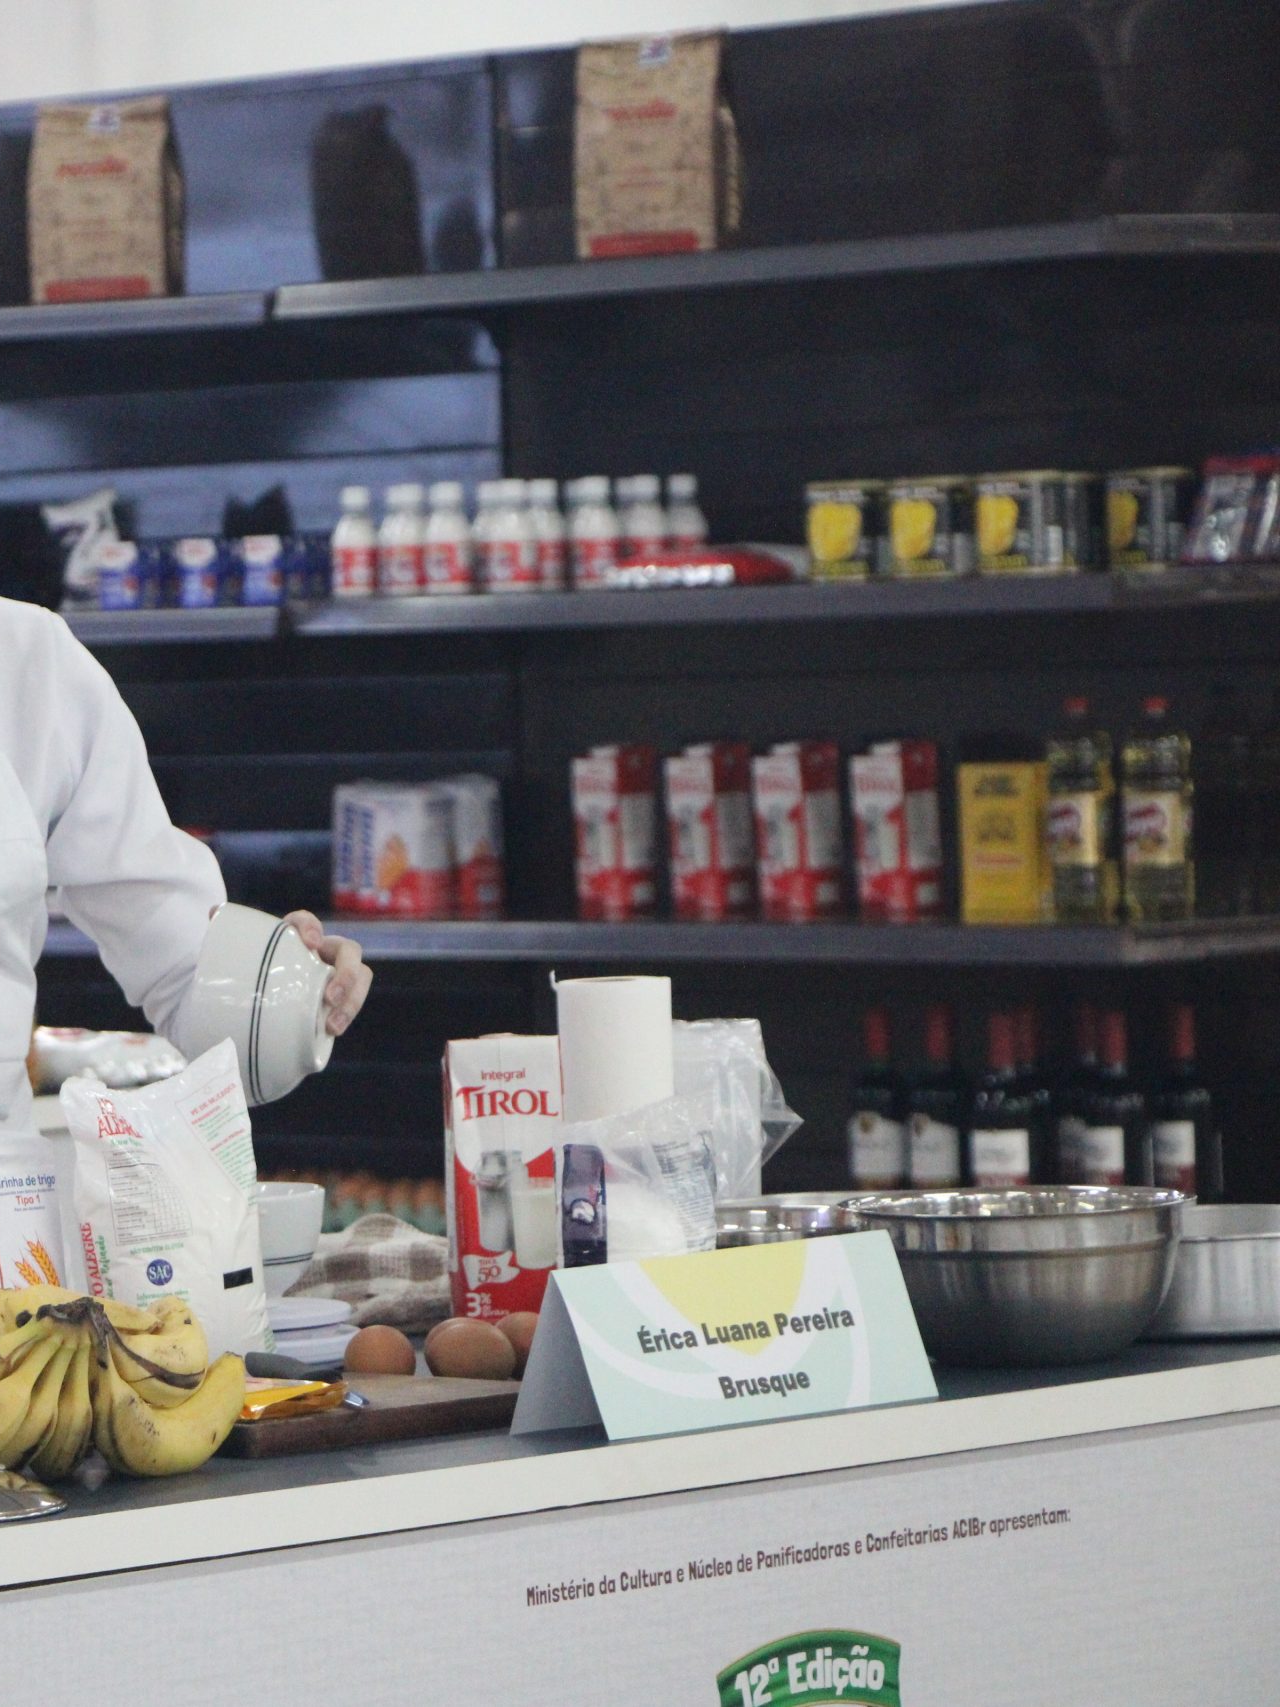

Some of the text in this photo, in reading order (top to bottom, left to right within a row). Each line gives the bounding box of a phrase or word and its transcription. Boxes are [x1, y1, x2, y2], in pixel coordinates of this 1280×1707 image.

[456, 1085, 559, 1122] TIROL
[25, 1175, 37, 1186] de
[37, 1174, 56, 1188] trigo
[15, 1195, 35, 1206] Tipo
[80, 1222, 102, 1281] ALEGRE
[148, 1264, 172, 1280] SAC
[637, 1307, 855, 1353] Érica Luana Pereira
[718, 1371, 811, 1399] Brusque
[526, 1508, 1072, 1606] Ministério da Cultura e Núcleo de Panificadoras e Confeitarias ACIBr apresentam:
[787, 1645, 886, 1696] Edição
